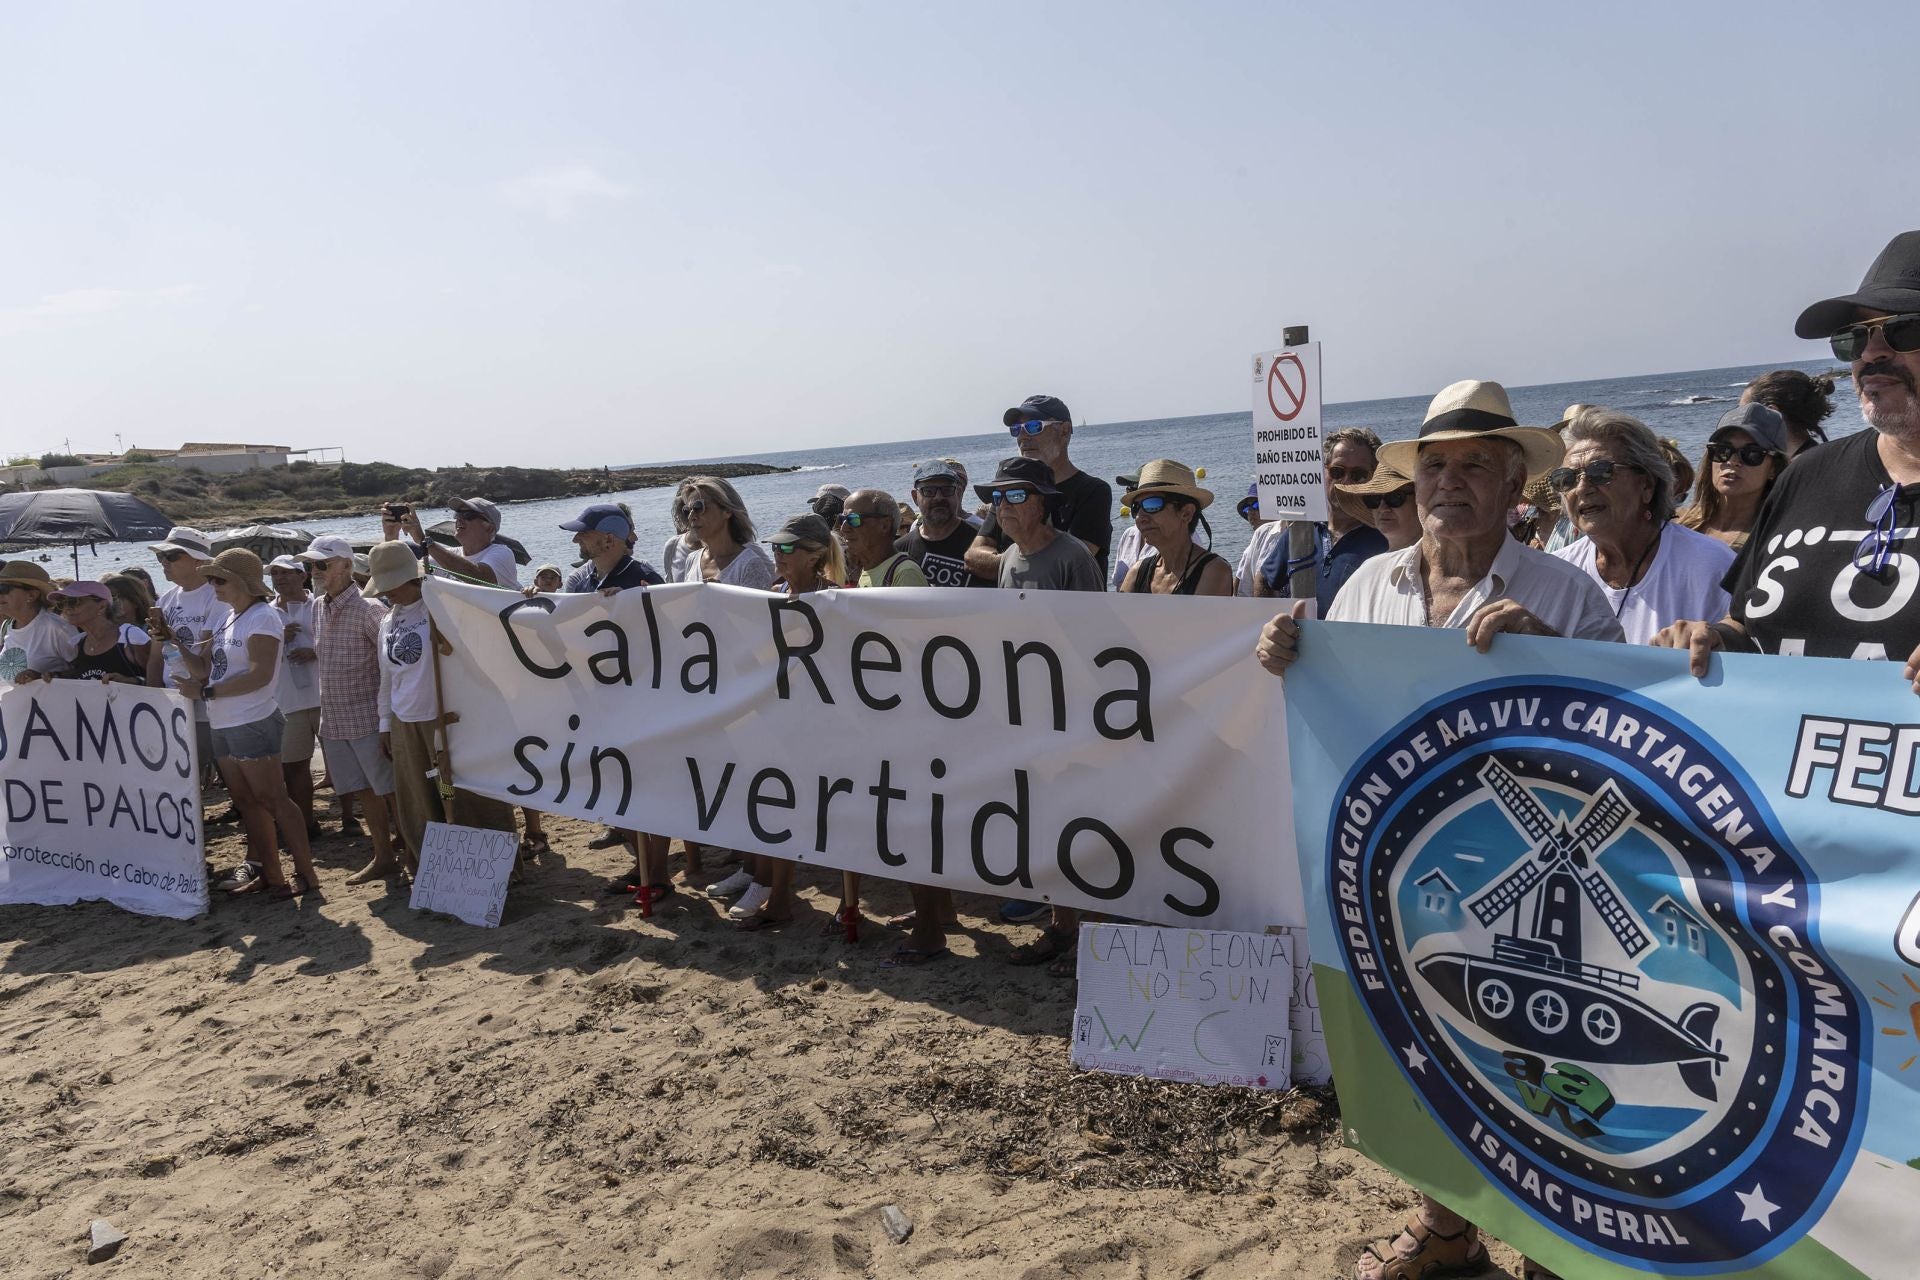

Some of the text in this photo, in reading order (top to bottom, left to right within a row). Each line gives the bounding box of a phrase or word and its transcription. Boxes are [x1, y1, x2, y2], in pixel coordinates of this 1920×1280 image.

[1257, 426, 1318, 442] PROHIBIDO EL
[1257, 449, 1321, 464] BAÑO EN ZONA
[1259, 472, 1321, 486] ACOTADA CON
[1276, 495, 1306, 507] BOYAS
[926, 565, 963, 587] SOS
[500, 592, 1155, 743] Cala Reona
[1387, 731, 1438, 780] DE
[1562, 700, 1776, 875] CARTAGENA
[5, 779, 196, 846] DE PALOS
[506, 713, 1221, 918] sin vertidos
[425, 827, 514, 860] QUEREMOS
[3, 845, 95, 874] protección
[100, 859, 120, 879] de
[124, 864, 158, 888] Cabo
[160, 872, 176, 892] de
[426, 849, 497, 880] BAÑARNOS
[416, 889, 436, 909] EN
[420, 872, 439, 891] EN
[490, 882, 507, 901] NO
[1338, 773, 1393, 992] FEDERACIÓN
[1761, 879, 1796, 909] Y
[1090, 927, 1169, 970] CALA
[1186, 932, 1290, 969] REONA
[1128, 969, 1270, 1004] NO ES UN
[1768, 925, 1848, 1149] COMARCA
[1469, 1120, 1690, 1246] ISAAC PERAL
